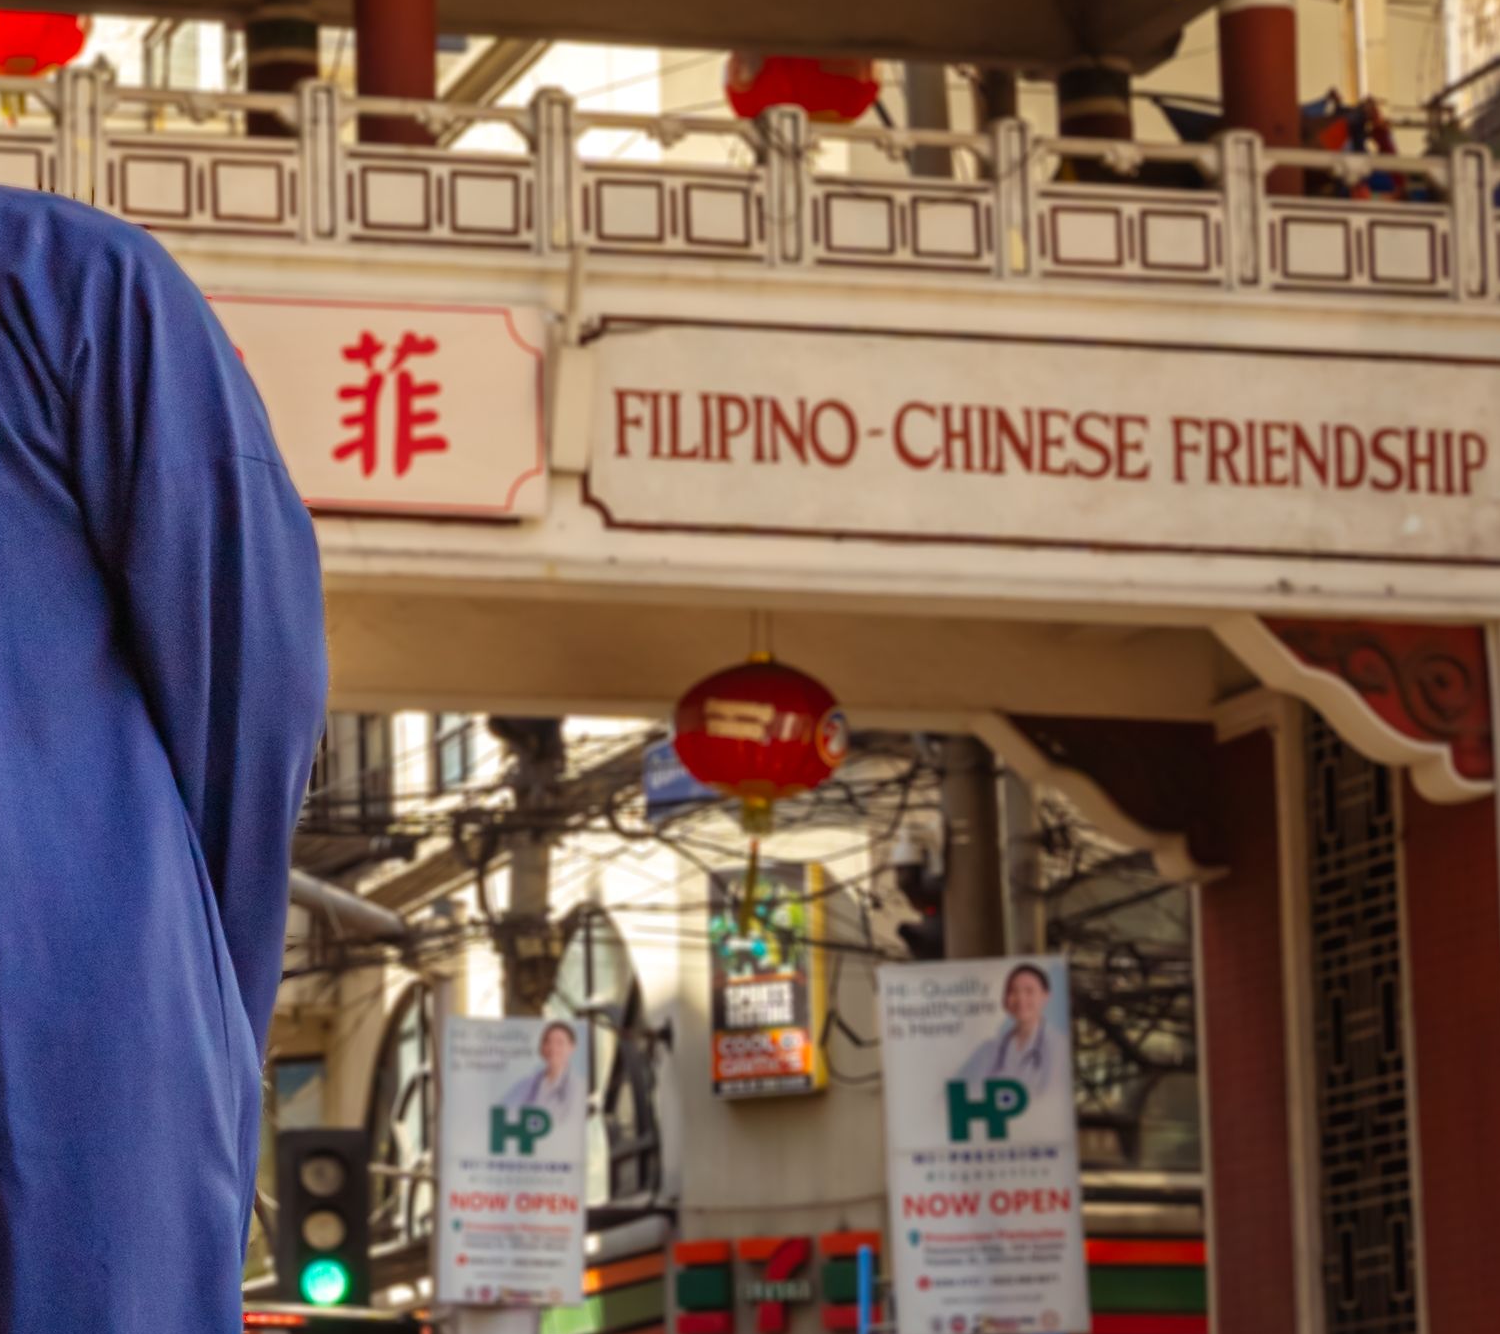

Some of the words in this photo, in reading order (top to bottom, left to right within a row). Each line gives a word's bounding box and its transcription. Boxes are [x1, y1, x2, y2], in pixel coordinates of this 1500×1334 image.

[332, 329, 450, 479] 菲
[1170, 415, 1488, 497] FRIENDSHIP
[489, 1104, 552, 1156] HP
[946, 1078, 1029, 1142] HP
[448, 1191, 508, 1214] NOW
[515, 1192, 578, 1216] OPEN
[902, 1190, 981, 1219] NOW
[990, 1187, 1071, 1216] OPEN
